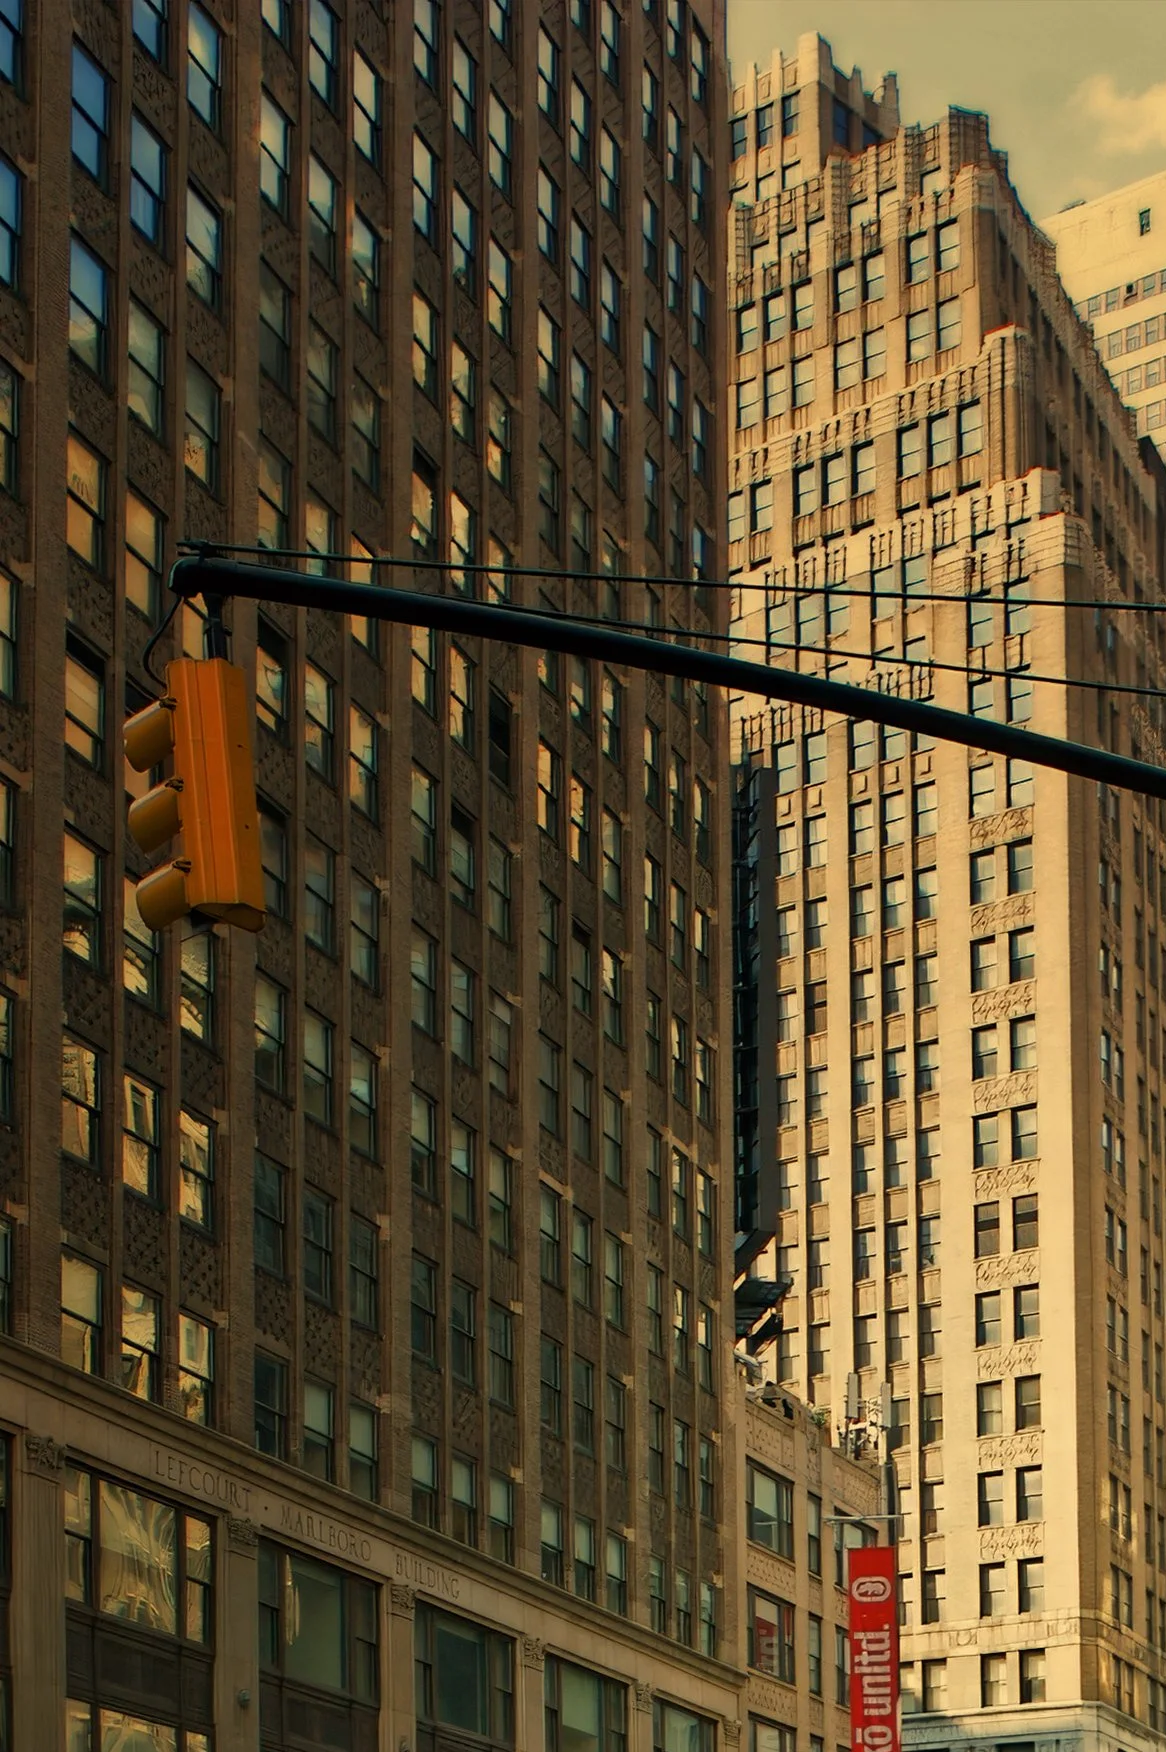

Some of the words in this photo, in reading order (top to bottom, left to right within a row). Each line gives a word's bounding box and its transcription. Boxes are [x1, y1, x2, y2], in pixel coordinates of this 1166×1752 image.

[155, 1450, 251, 1512] LEFCOURT
[281, 1504, 372, 1562] MARLBORO
[396, 1553, 460, 1600] BUILDING
